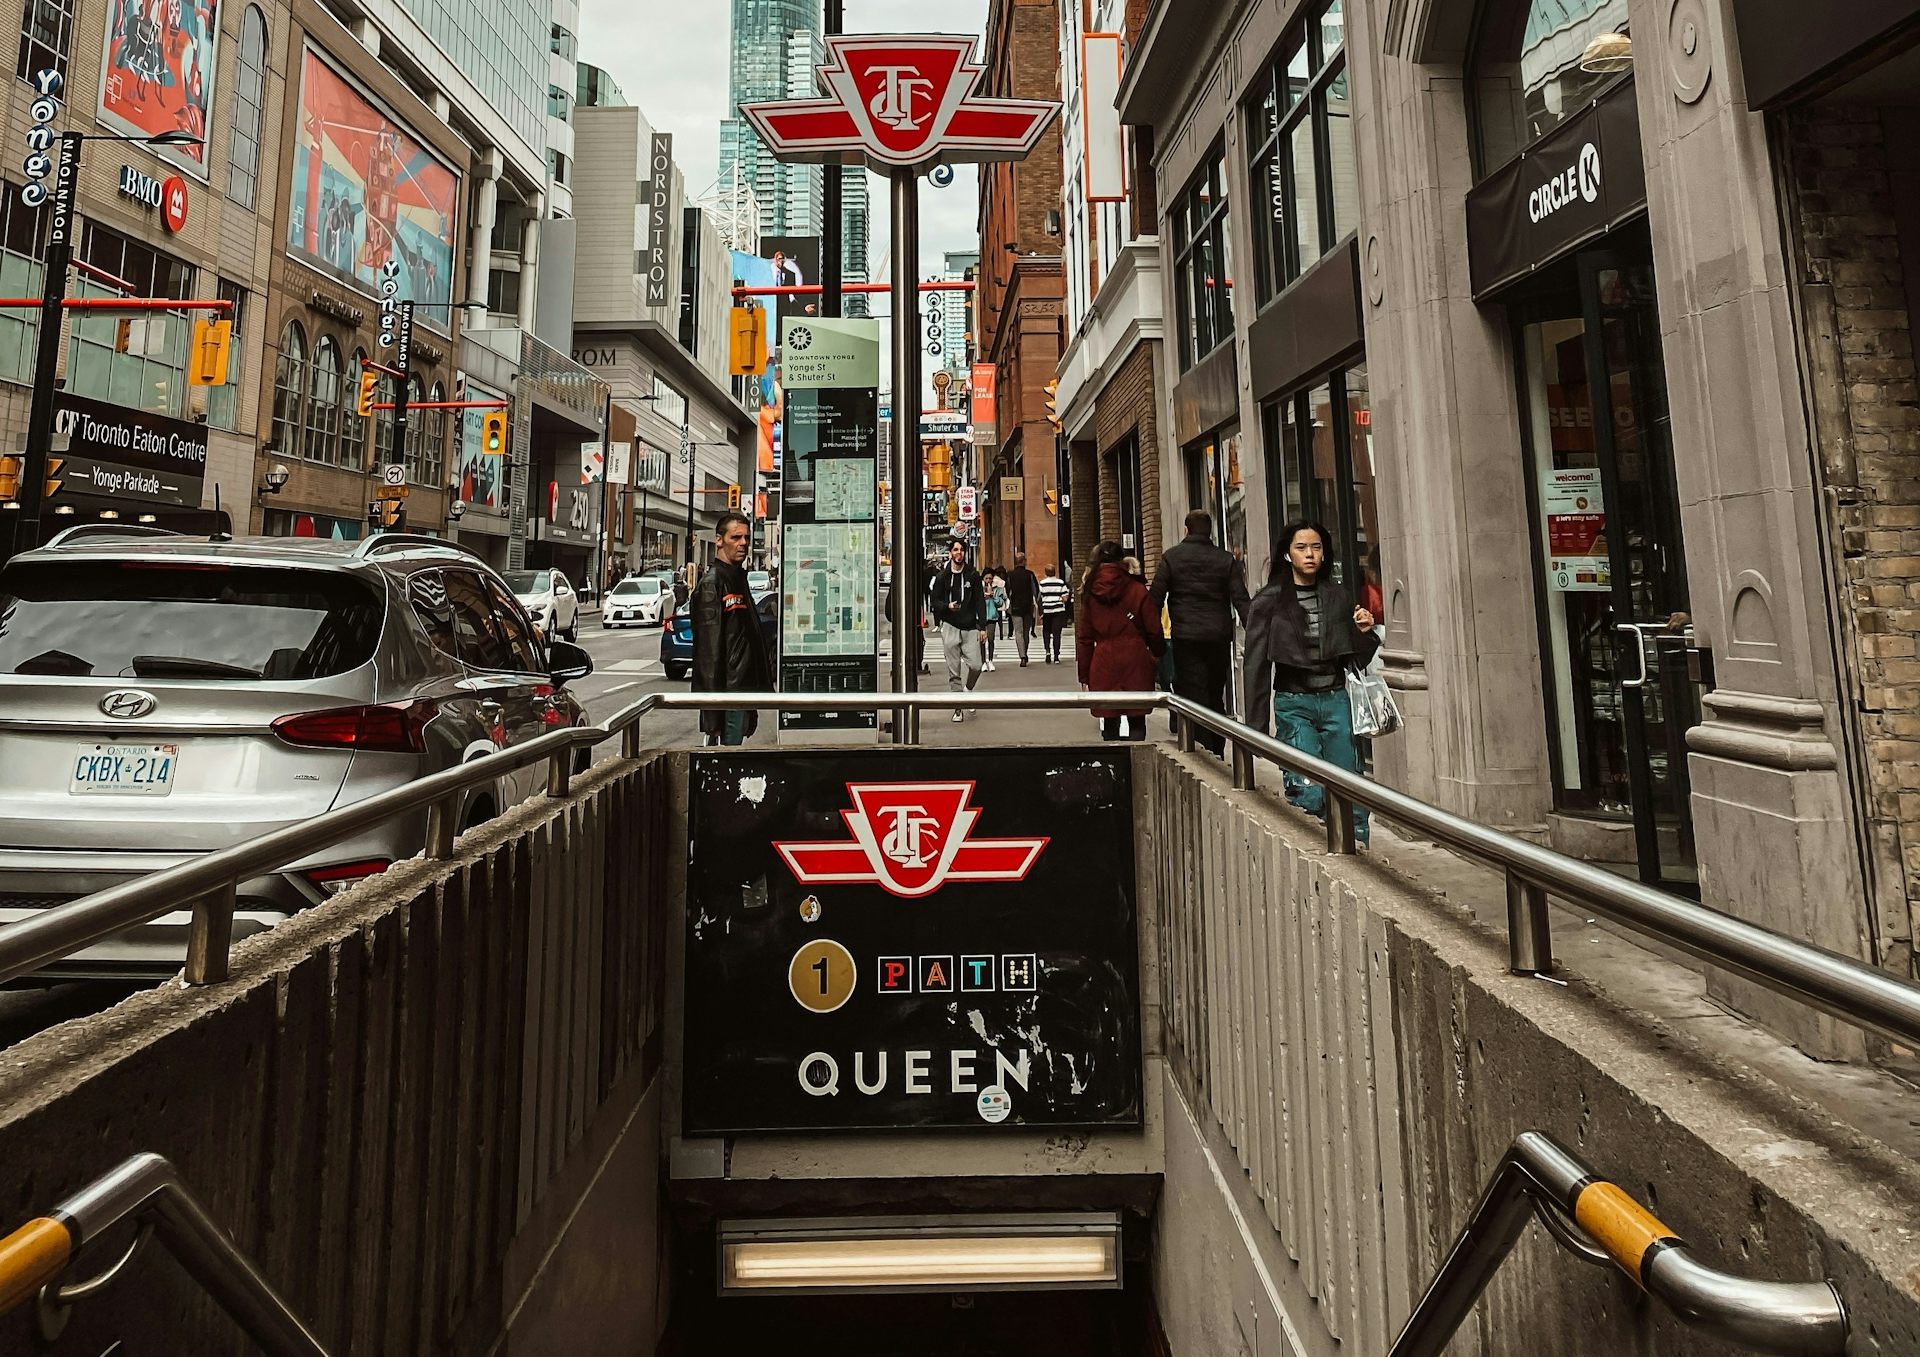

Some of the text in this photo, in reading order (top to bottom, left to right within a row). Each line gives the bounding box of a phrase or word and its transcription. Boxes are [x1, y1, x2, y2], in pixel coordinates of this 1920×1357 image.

[22, 69, 62, 207] Yonge
[53, 139, 75, 241] DOWNTOWN
[125, 165, 162, 207] BMO
[1528, 147, 1600, 223] CIRCLE K
[649, 137, 668, 300] NORDSTROM
[378, 260, 400, 348] Yonge
[399, 304, 411, 368] DOWNTOWN
[789, 363, 826, 372] Yonge St
[56, 409, 206, 462] CF Toronto Eaton Centre
[928, 423, 950, 431] Shuter
[92, 466, 160, 494] Yonge Parkade
[1555, 473, 1594, 482] welcome!
[76, 756, 170, 783] CKBX 214
[107, 747, 147, 755] ONTARIO
[812, 957, 1031, 995] 1 PATH
[799, 1049, 1030, 1096] QUEEN
